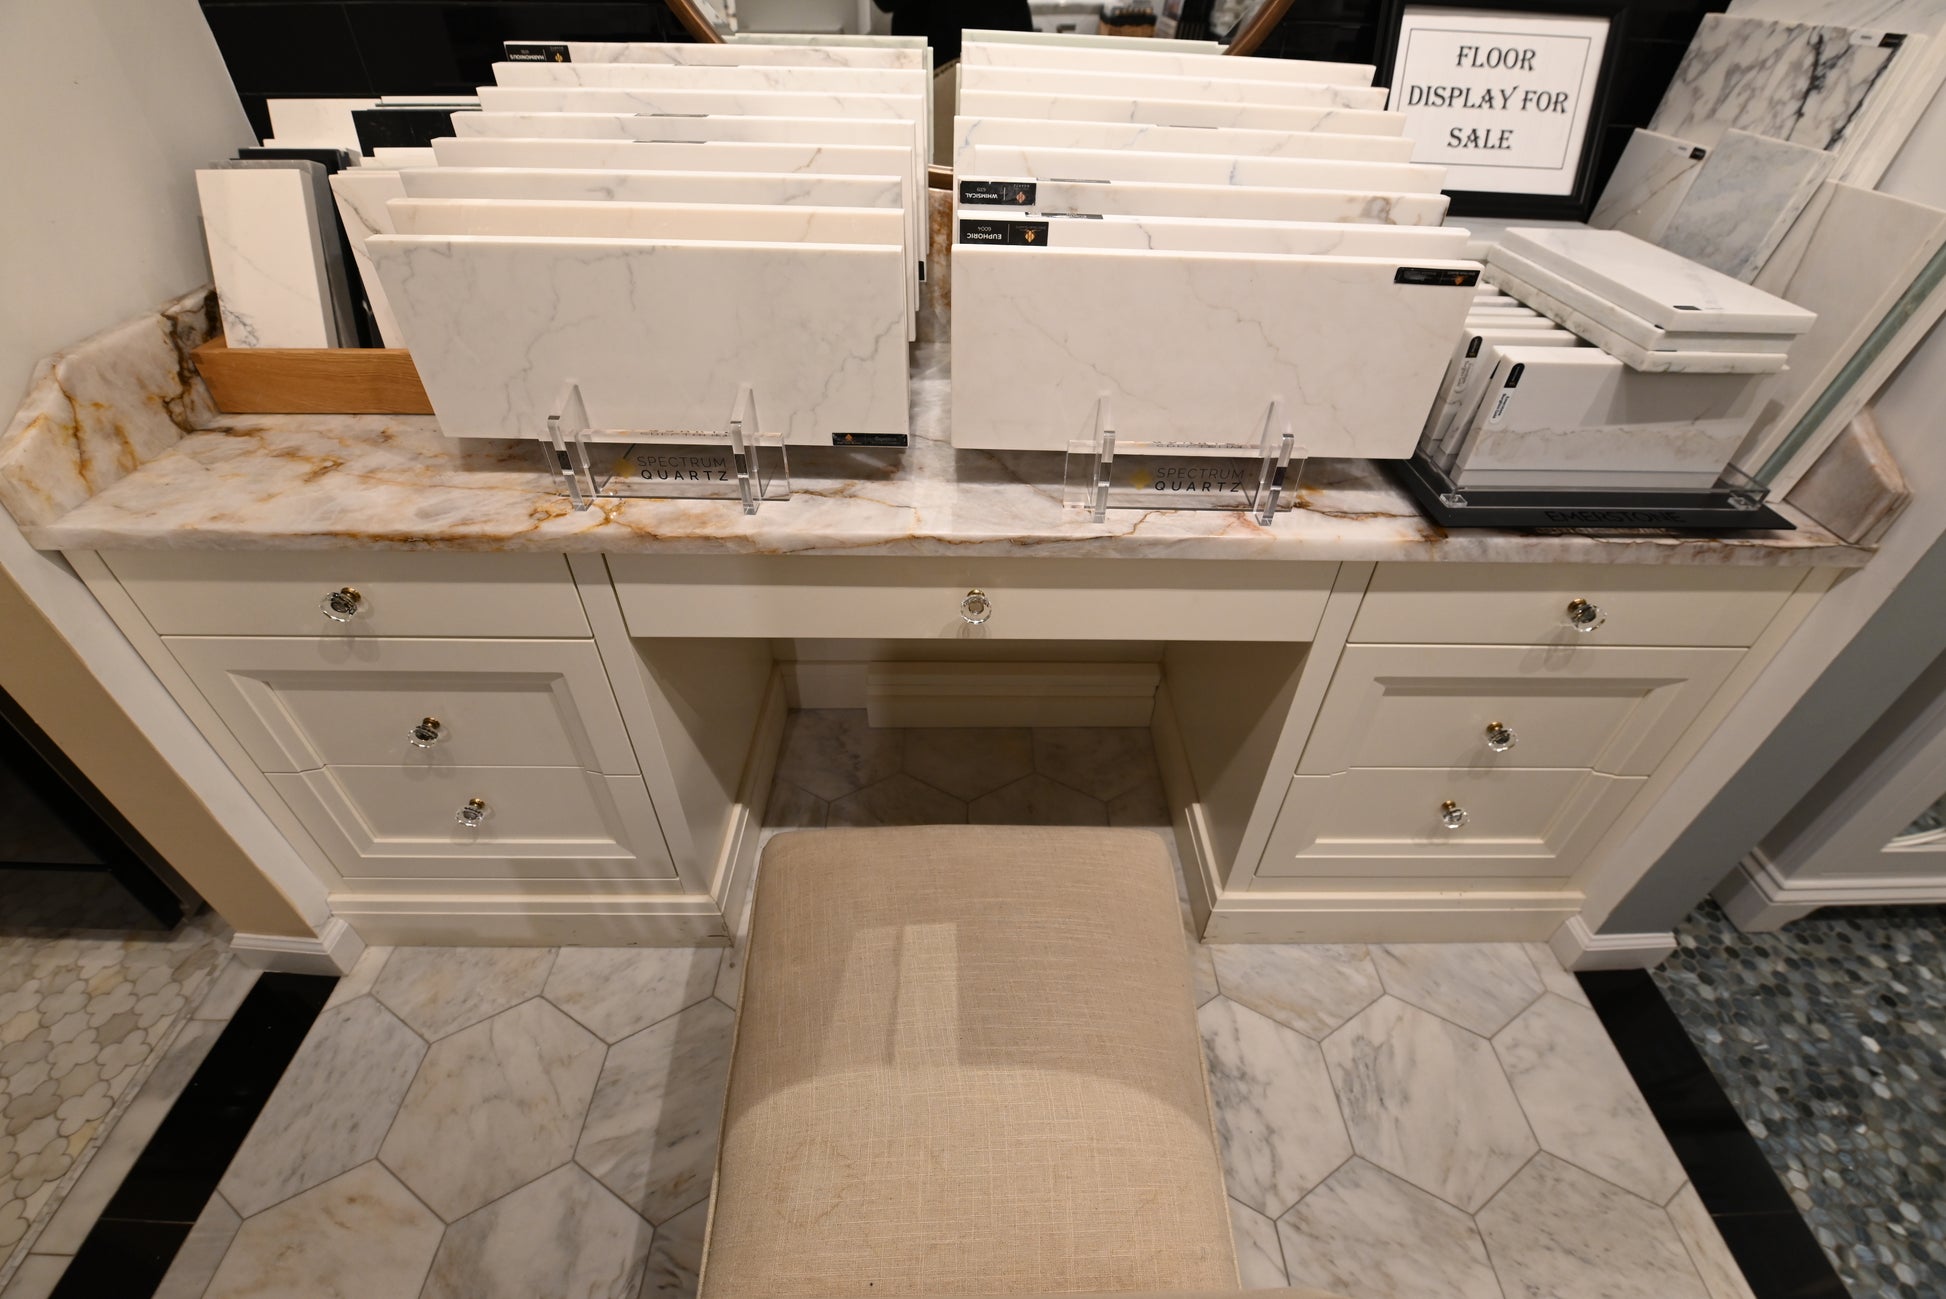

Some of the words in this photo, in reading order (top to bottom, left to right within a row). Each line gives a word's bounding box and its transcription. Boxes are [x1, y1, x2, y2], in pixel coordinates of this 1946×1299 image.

[1456, 45, 1537, 71] FLOOR
[1407, 84, 1520, 110] DISPLAY
[1520, 90, 1569, 114] FOR
[1447, 126, 1514, 151] SALE
[965, 192, 998, 200] WHIMSICAL
[966, 232, 1002, 240] EUPHORIC
[637, 455, 727, 468] SPECTRUM
[641, 469, 729, 481] QUARTZ
[1157, 467, 1245, 480] SPECTRUM
[1154, 480, 1241, 493] QUARTZ
[1543, 510, 1687, 523] EMERSTONE
